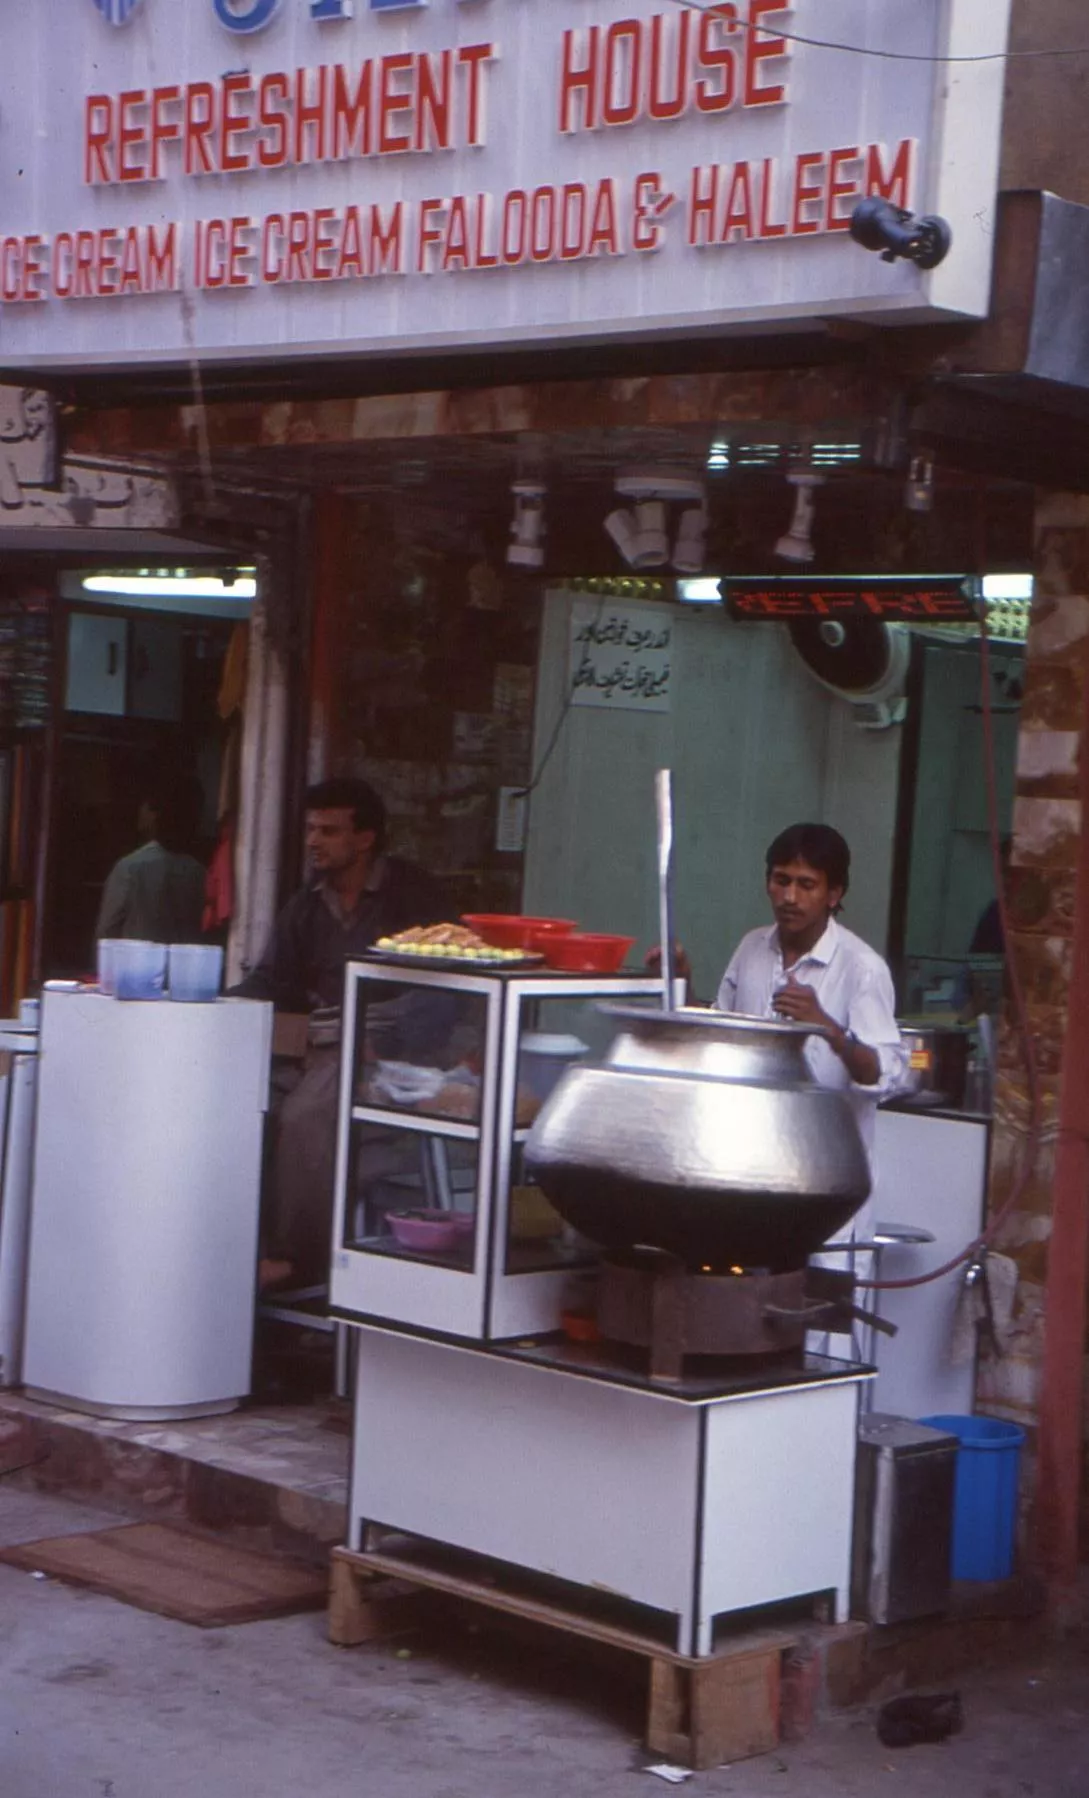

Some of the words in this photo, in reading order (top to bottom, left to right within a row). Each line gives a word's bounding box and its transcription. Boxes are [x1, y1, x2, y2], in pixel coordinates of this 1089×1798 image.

[85, 43, 493, 184] REFRESHMENT
[559, 0, 791, 132] HOUSE
[54, 222, 177, 298] CREAM
[195, 216, 252, 288] ICE
[262, 202, 404, 284] CREAM
[418, 178, 616, 273] FALOODA
[632, 172, 676, 250] &
[689, 138, 913, 245] HALEEM
